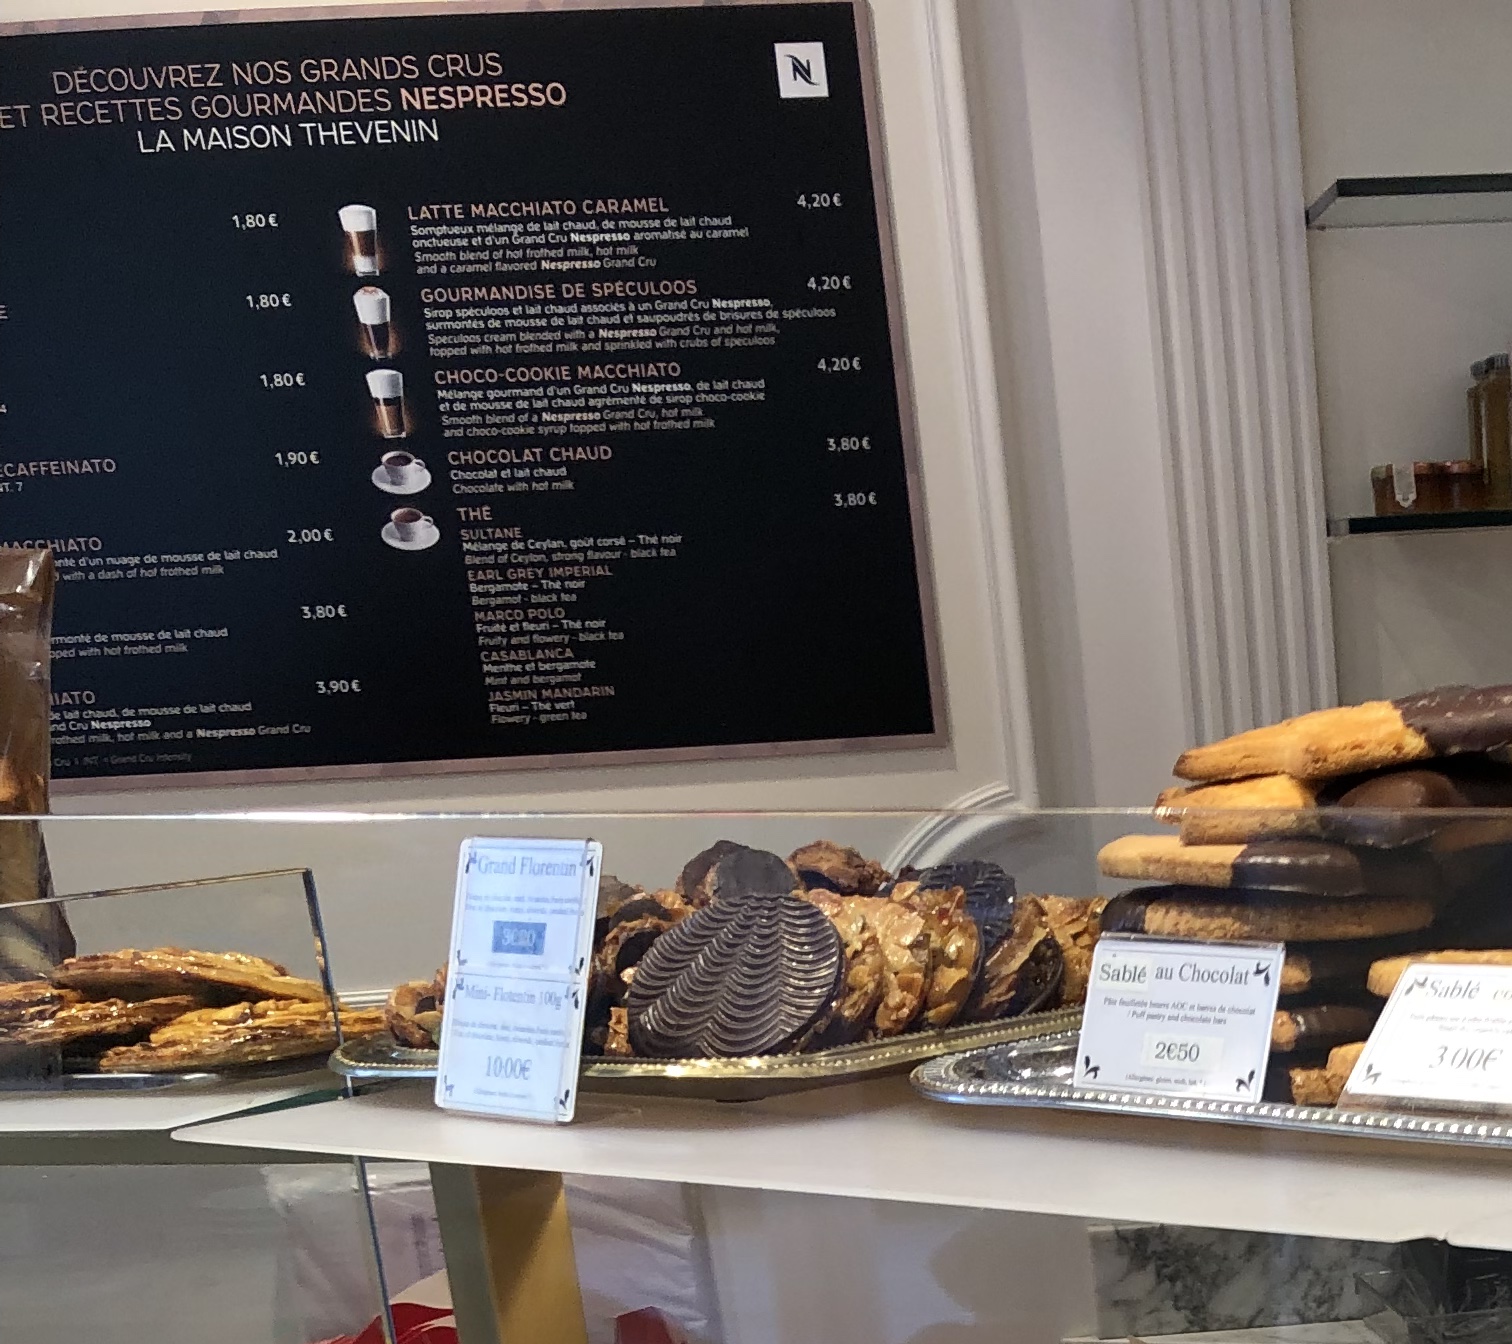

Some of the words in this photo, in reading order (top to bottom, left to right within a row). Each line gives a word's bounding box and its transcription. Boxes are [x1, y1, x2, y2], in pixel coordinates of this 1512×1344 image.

[52, 63, 222, 94] DÉCOUVREZ
[232, 60, 291, 85] NOS
[300, 55, 418, 82] GRANDS
[428, 52, 502, 78] CRUS
[0, 105, 30, 129] ET
[41, 96, 182, 125] RECETTES
[191, 88, 391, 118] GOURMANDES
[400, 82, 566, 110] NESPRESSO
[137, 129, 174, 152] LA
[183, 124, 291, 150] MAISON
[299, 118, 438, 145] THEVENIN
[407, 204, 463, 220] LATTE
[471, 200, 576, 217] MACCHIATO
[582, 197, 668, 214] CARAMEL
[420, 284, 554, 302] GOURMANDISE
[562, 282, 584, 298] DE
[592, 279, 697, 297] SPÉCULOOS
[434, 366, 570, 384] CHOCO-COOKIE
[577, 362, 680, 379] MACCHIATO
[447, 447, 542, 465] CHOCOLAT
[549, 445, 612, 461] CHAUD
[0, 459, 116, 478] CAFFEINATO
[456, 505, 492, 521] THÉ
[460, 527, 521, 540] SULTANE
[467, 569, 502, 581] EARL
[507, 567, 543, 579] GREY
[549, 565, 612, 577] IMPERIAL
[474, 609, 523, 621] MARCO
[527, 607, 565, 619] POLO
[480, 647, 574, 662] CASABLANCA
[488, 689, 537, 701] JASMIN
[542, 685, 614, 698] MANDARIN
[1099, 963, 1146, 983] Sablé
[1155, 966, 1173, 980] au
[1178, 962, 1249, 985] Chocolat
[1426, 978, 1480, 999] Sablé
[1154, 1042, 1199, 1062] 2€50
